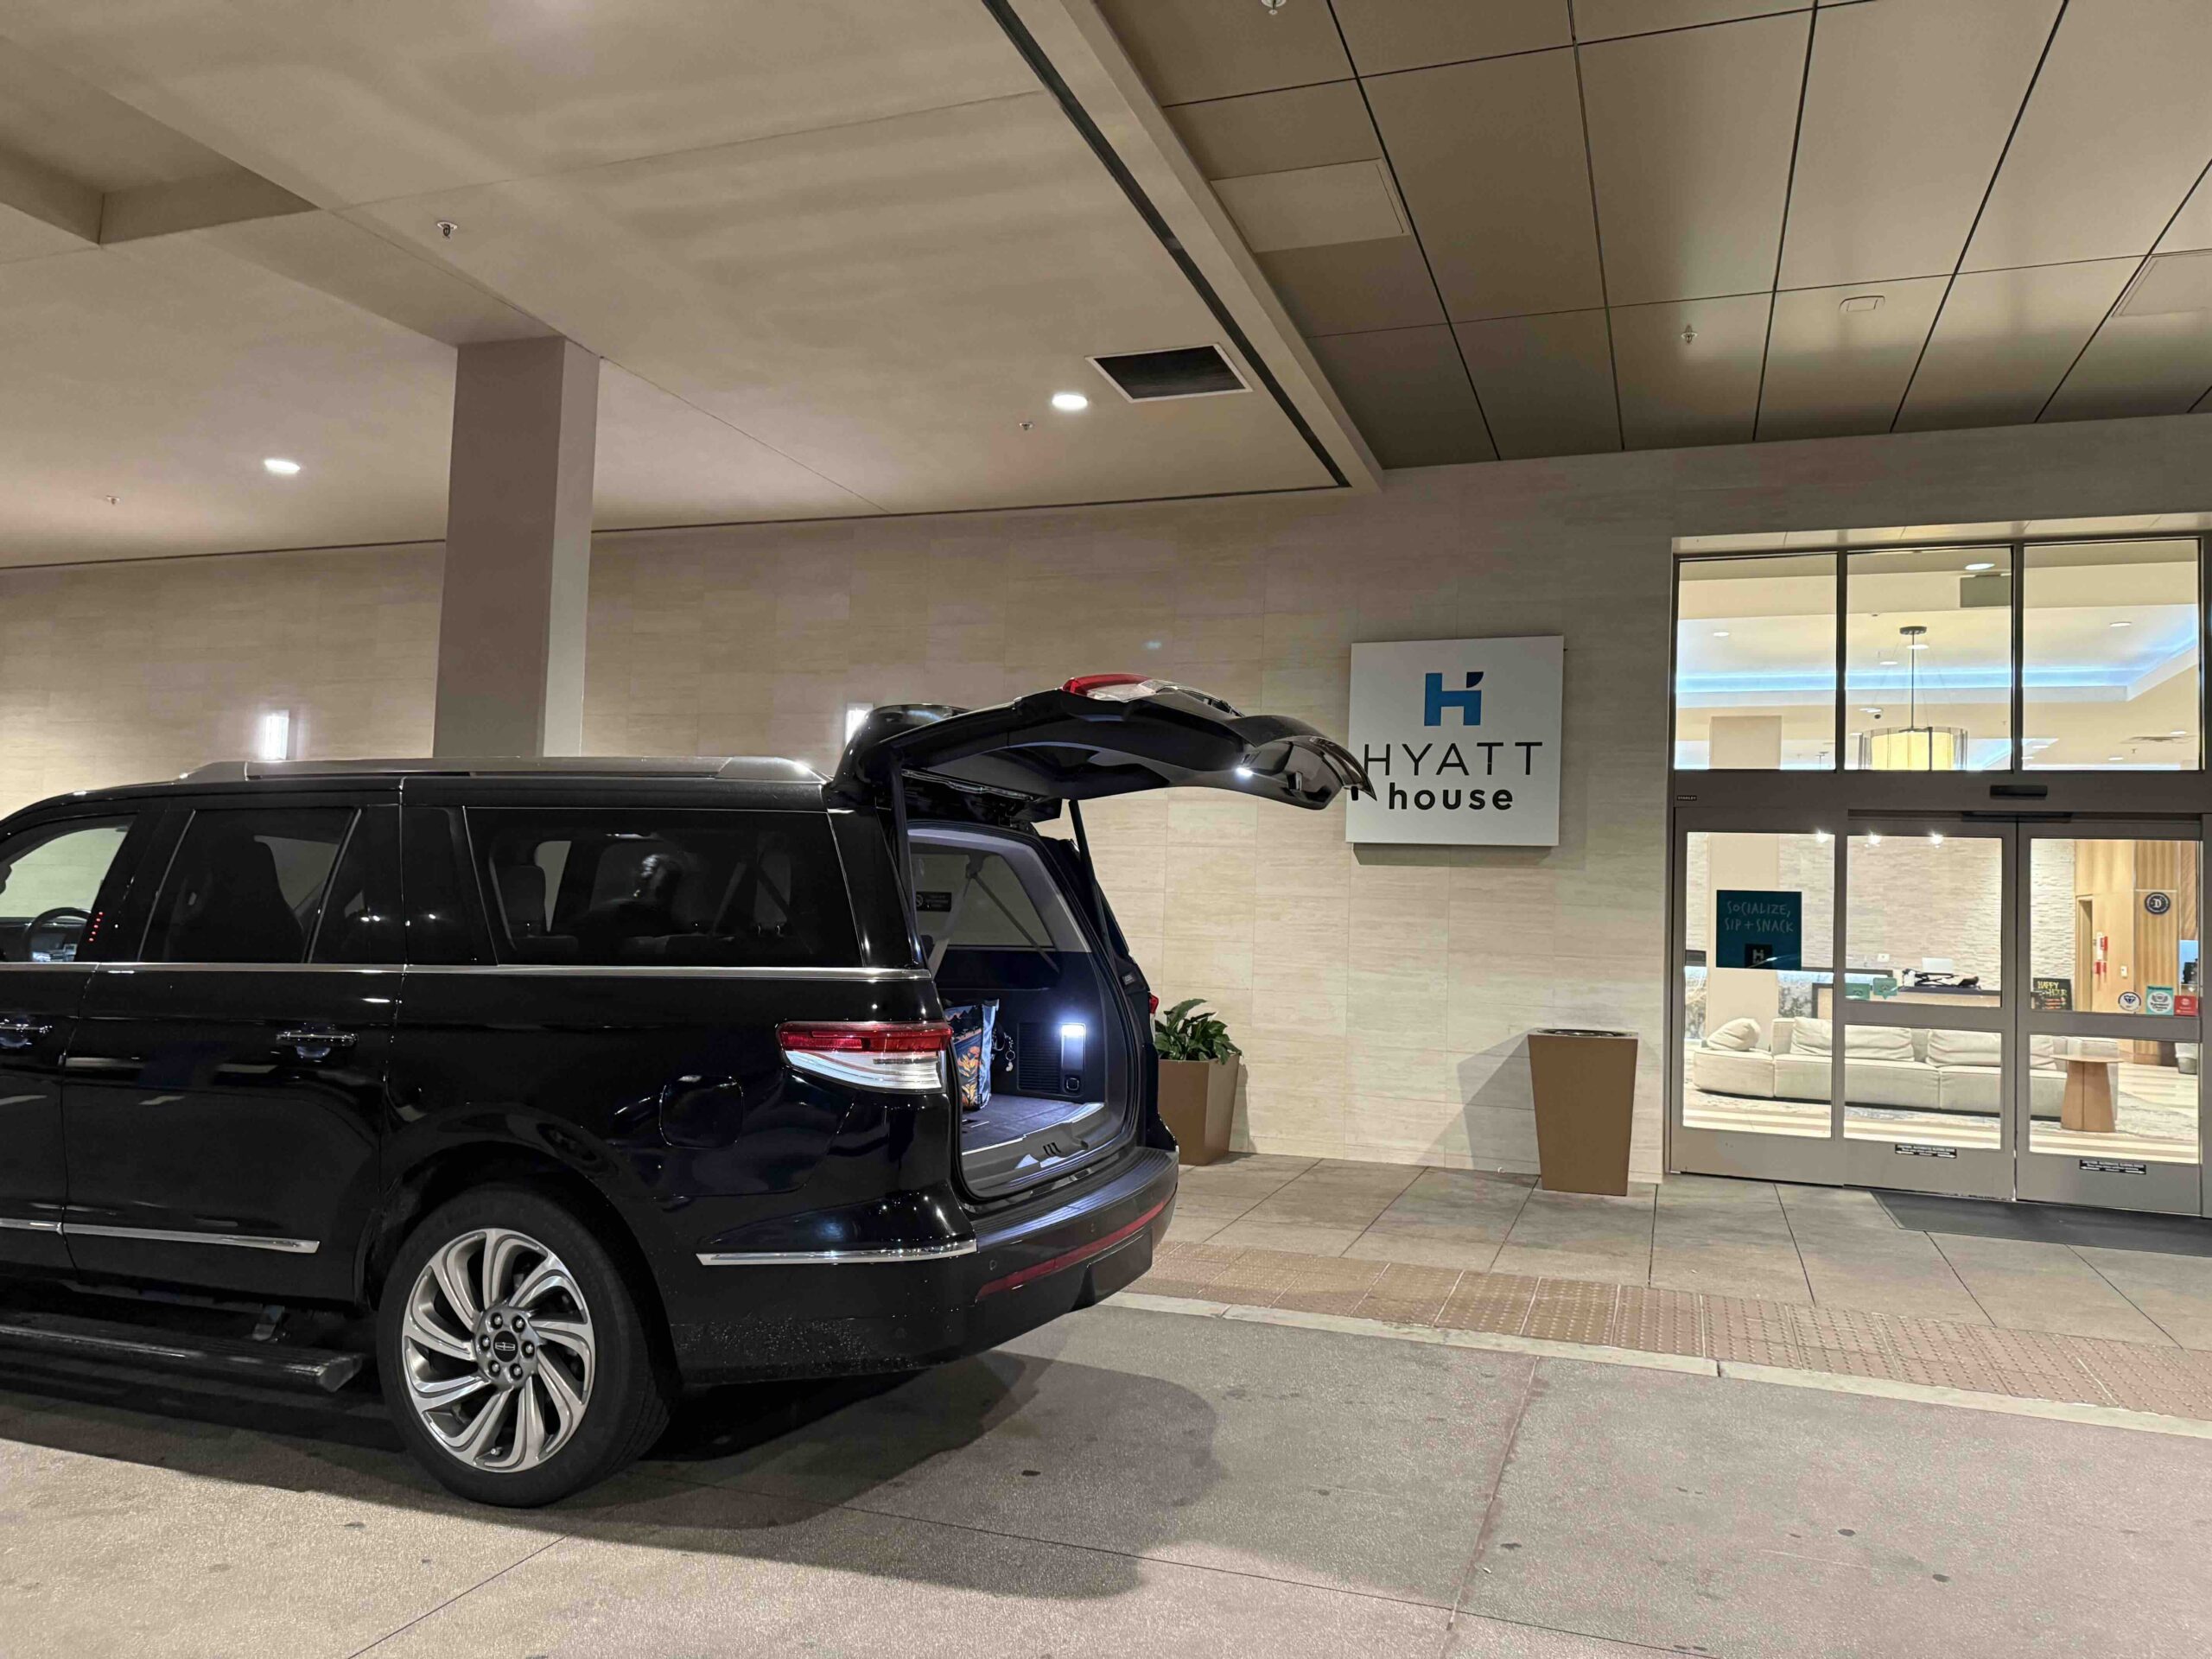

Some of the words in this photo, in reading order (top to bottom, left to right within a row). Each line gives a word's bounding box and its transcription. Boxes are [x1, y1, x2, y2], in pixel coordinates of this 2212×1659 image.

[1363, 741, 1543, 776] HYATT
[1389, 782, 1513, 810] house
[1725, 918, 1742, 931] SIP
[1756, 918, 1794, 933] SNACK
